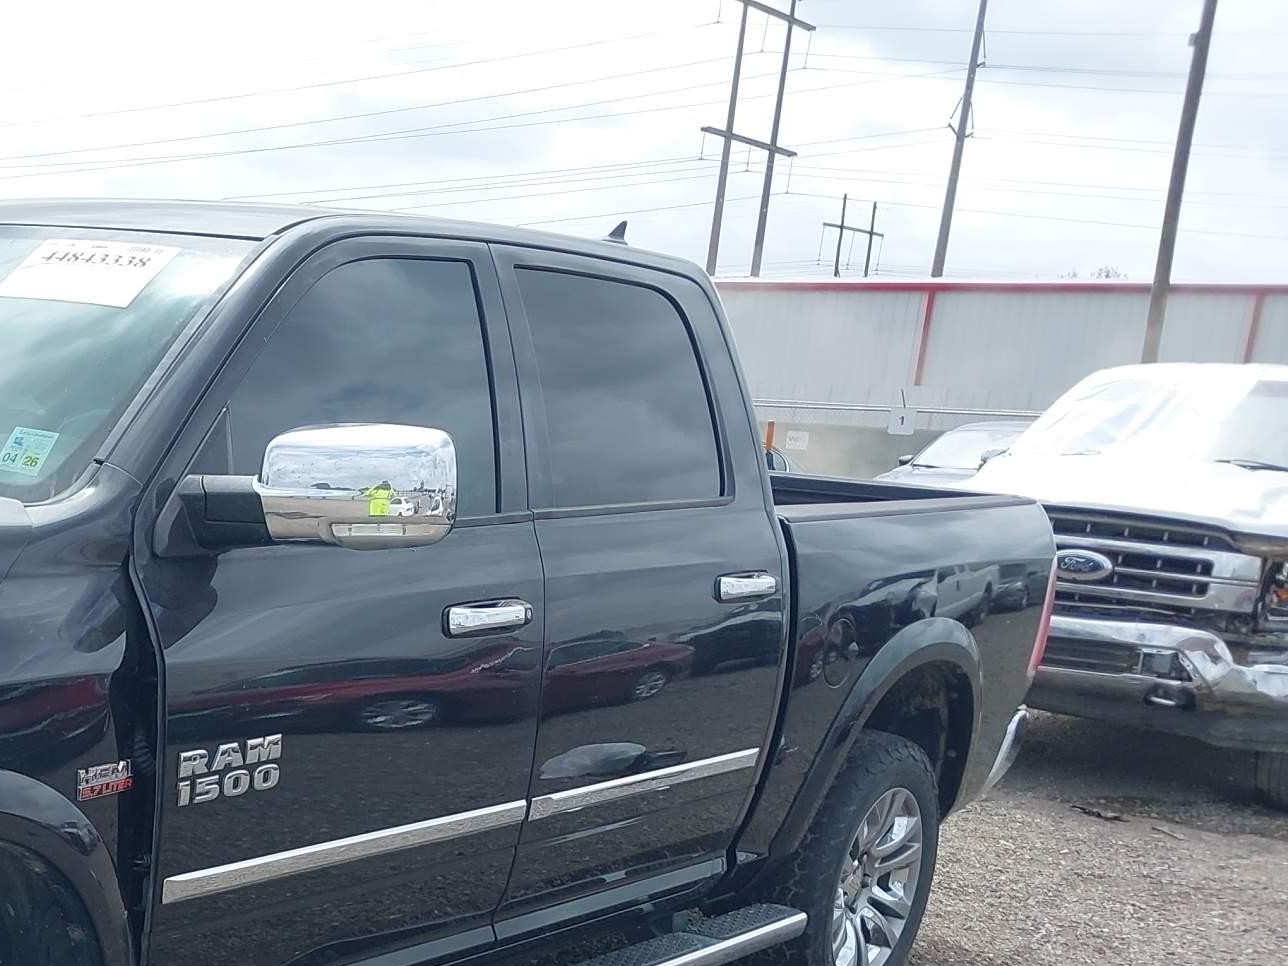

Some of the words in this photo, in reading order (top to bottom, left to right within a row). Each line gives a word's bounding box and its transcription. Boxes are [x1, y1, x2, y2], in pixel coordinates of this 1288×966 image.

[42, 250, 151, 268] 44843338
[2, 452, 18, 464] 04
[23, 455, 40, 468] 26
[1060, 556, 1094, 572] Ford
[178, 733, 284, 779] RAM
[82, 785, 101, 799] 5.7
[102, 777, 133, 794] LITER
[176, 763, 281, 807] 1500
